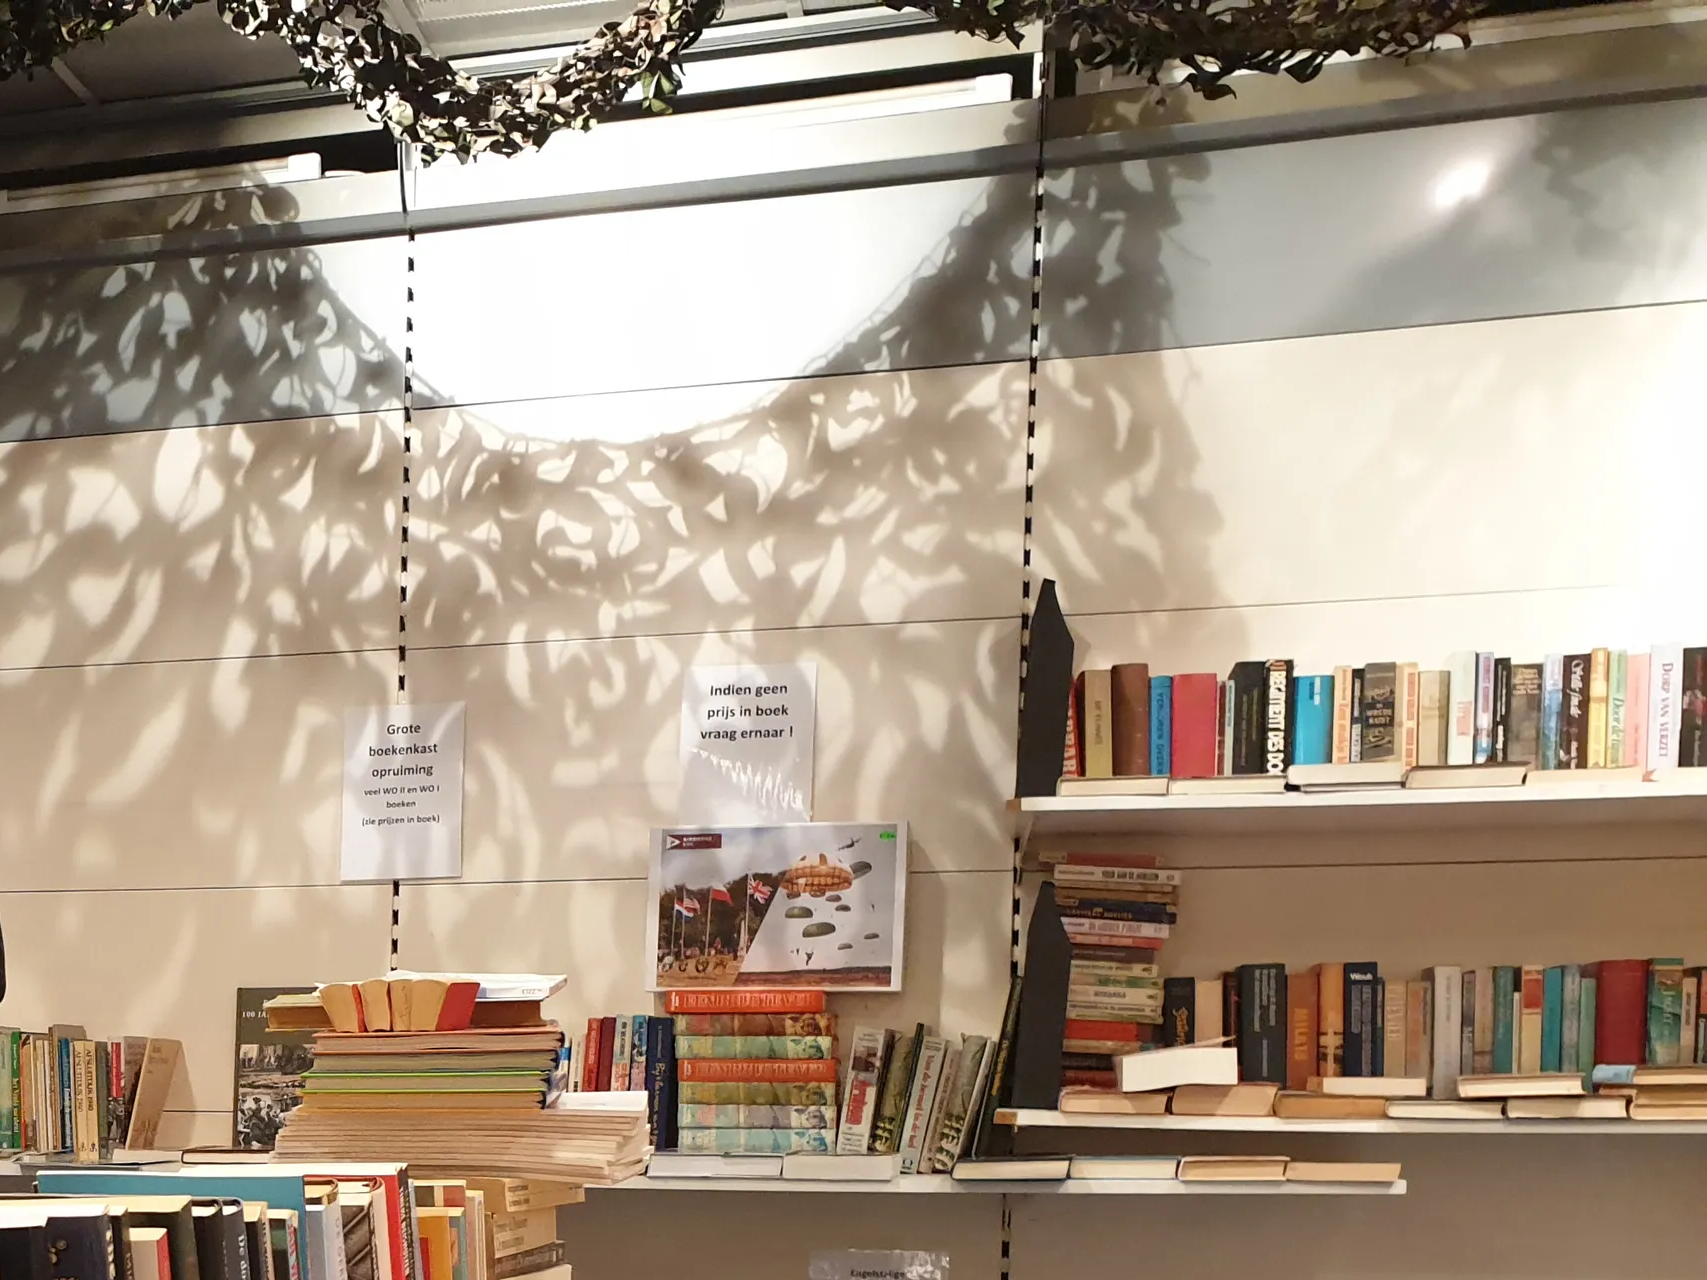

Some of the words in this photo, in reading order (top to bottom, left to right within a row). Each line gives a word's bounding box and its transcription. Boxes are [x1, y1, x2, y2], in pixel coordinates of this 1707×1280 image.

[710, 684, 752, 697] Indien
[755, 685, 788, 698] geen
[707, 706, 735, 720] prijs
[739, 705, 752, 718] in
[755, 704, 789, 717] boek
[386, 724, 421, 735] Grote
[700, 728, 737, 742] vraag
[740, 727, 785, 739] ernaar
[368, 743, 438, 758] boekenkast
[371, 764, 434, 779] opruiming
[364, 787, 381, 796] veel
[382, 786, 398, 795] WO
[407, 786, 418, 794] en
[419, 784, 435, 793] WO
[386, 801, 416, 809] boeken
[407, 815, 415, 824] in
